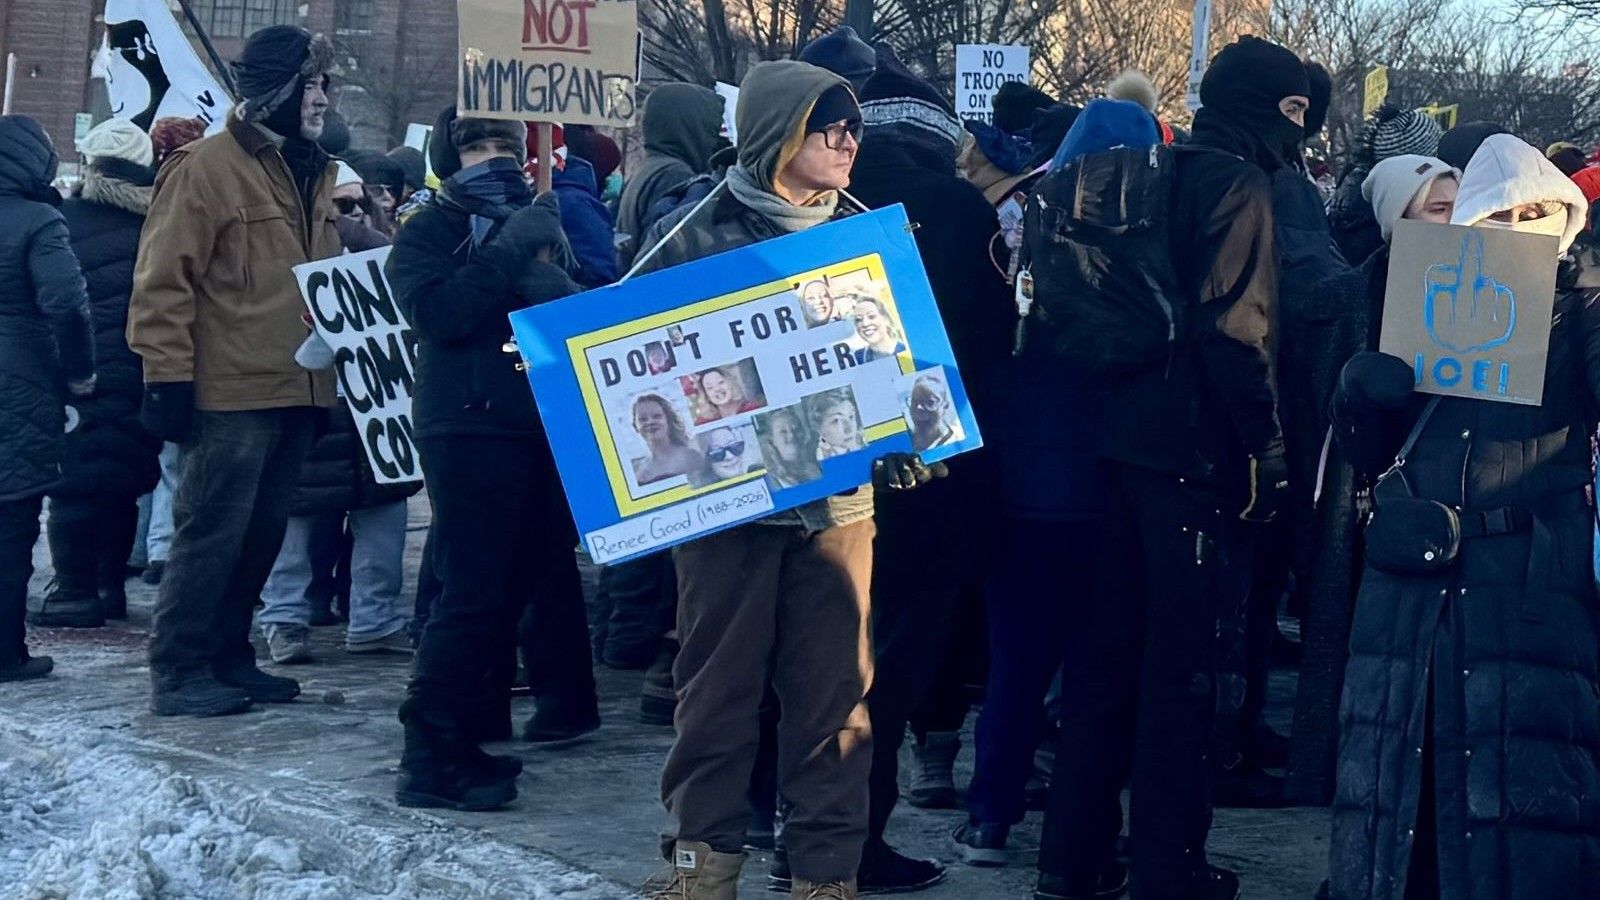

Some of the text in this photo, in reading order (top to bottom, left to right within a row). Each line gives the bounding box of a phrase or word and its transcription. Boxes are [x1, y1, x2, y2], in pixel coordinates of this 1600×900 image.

[521, 0, 596, 47] NOT
[982, 50, 1004, 68] NO
[463, 58, 635, 120] IMMIGRANTS
[968, 93, 987, 108] ON
[307, 259, 399, 334] CON
[728, 306, 798, 348] FOR
[789, 342, 857, 383] HER
[1414, 352, 1510, 396] ICE!
[591, 484, 770, 560] Renee Good (1988-2026)
